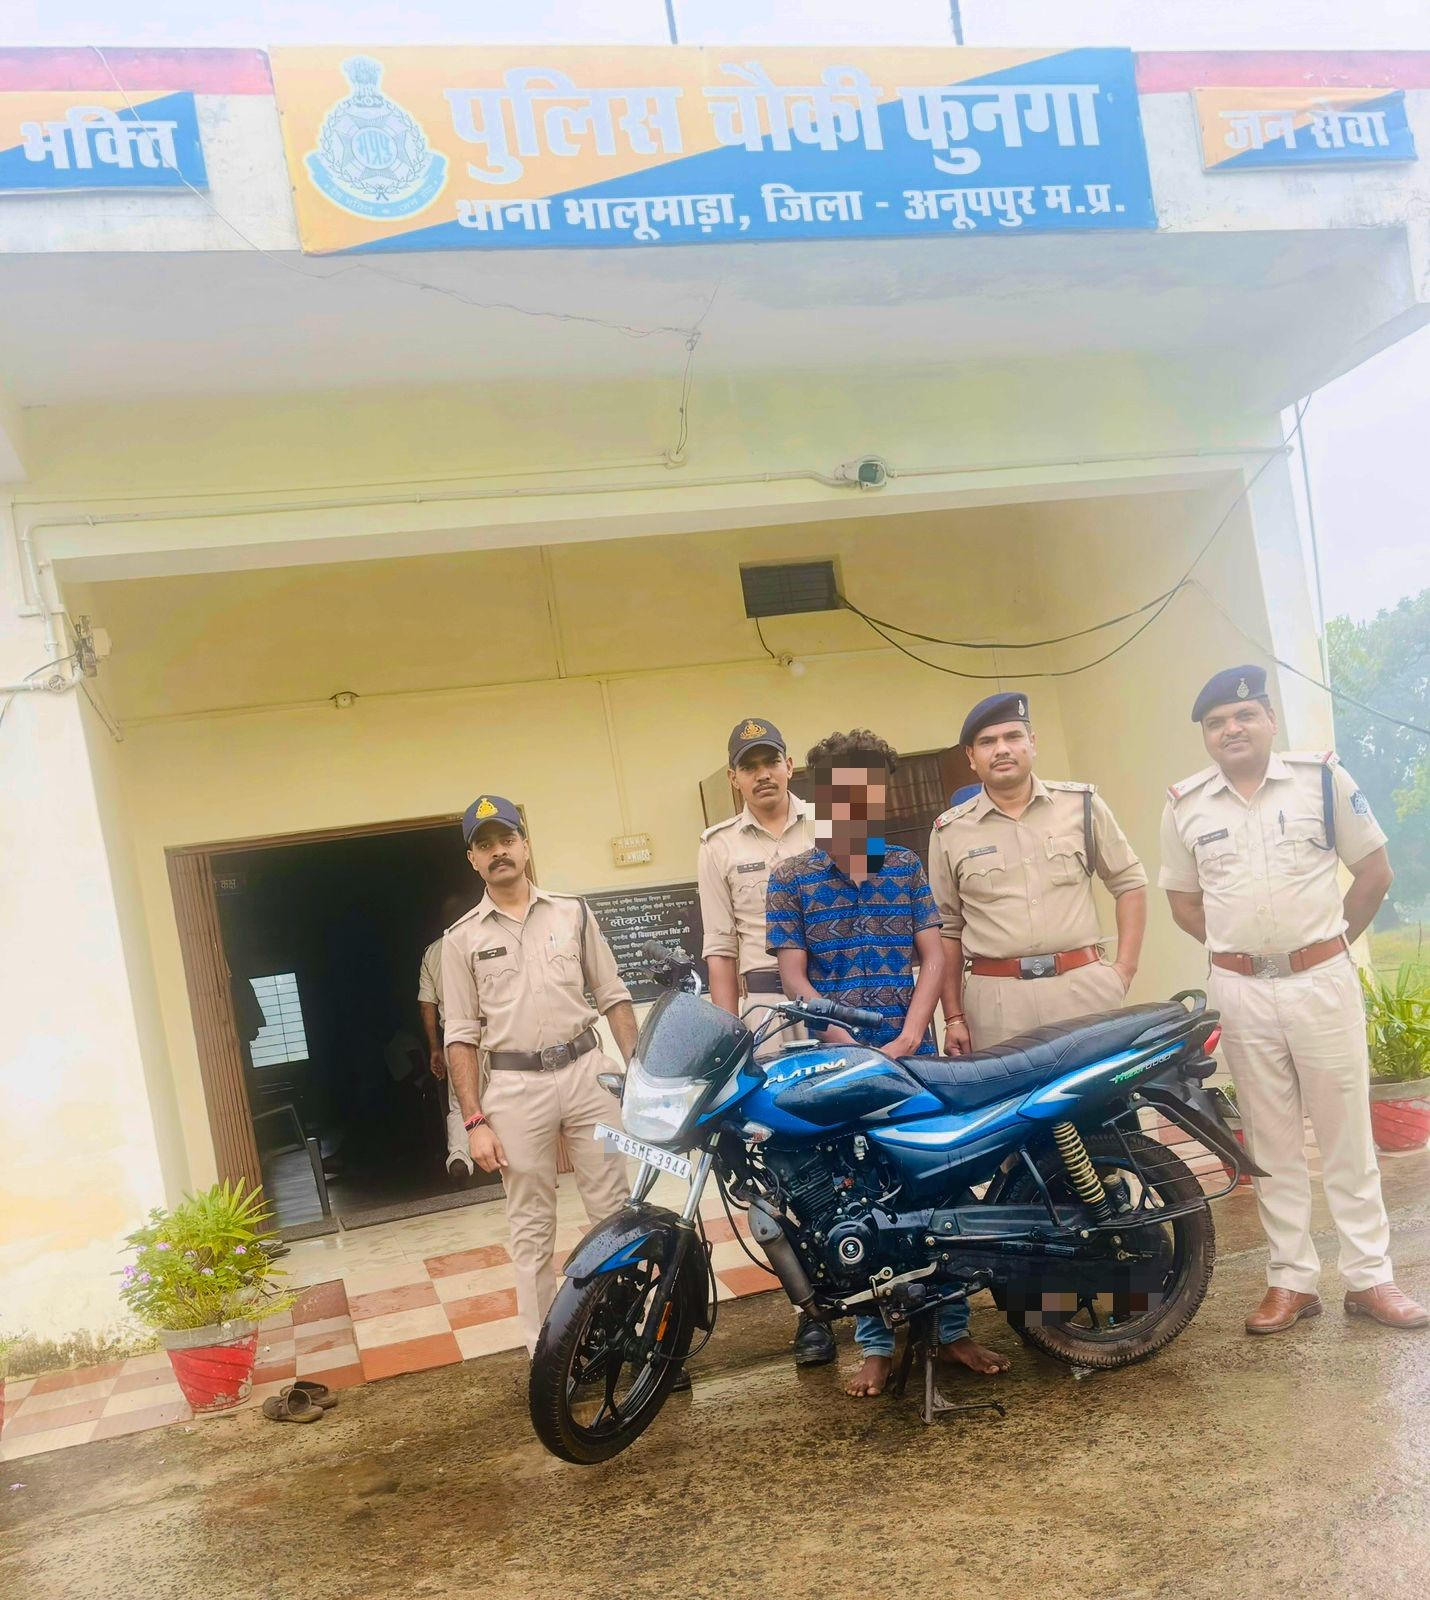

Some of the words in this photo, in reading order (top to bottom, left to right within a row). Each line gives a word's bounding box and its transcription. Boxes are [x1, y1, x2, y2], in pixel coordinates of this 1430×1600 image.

[20, 105, 178, 170] भक्ति
[443, 66, 684, 184] पुलिस
[703, 60, 883, 151] चौकी
[896, 84, 1100, 175] फुनगा
[1218, 110, 1297, 150] जन
[1306, 96, 1390, 149] सेवा
[456, 198, 551, 231] थाना
[564, 193, 751, 240] भालूमाड़ा,
[761, 183, 863, 223] जिला
[903, 186, 1037, 229] अनूपपुर
[1042, 184, 1126, 215] म.प्र.
[763, 1058, 847, 1090] PLATINA
[656, 1153, 687, 1176] 3944
